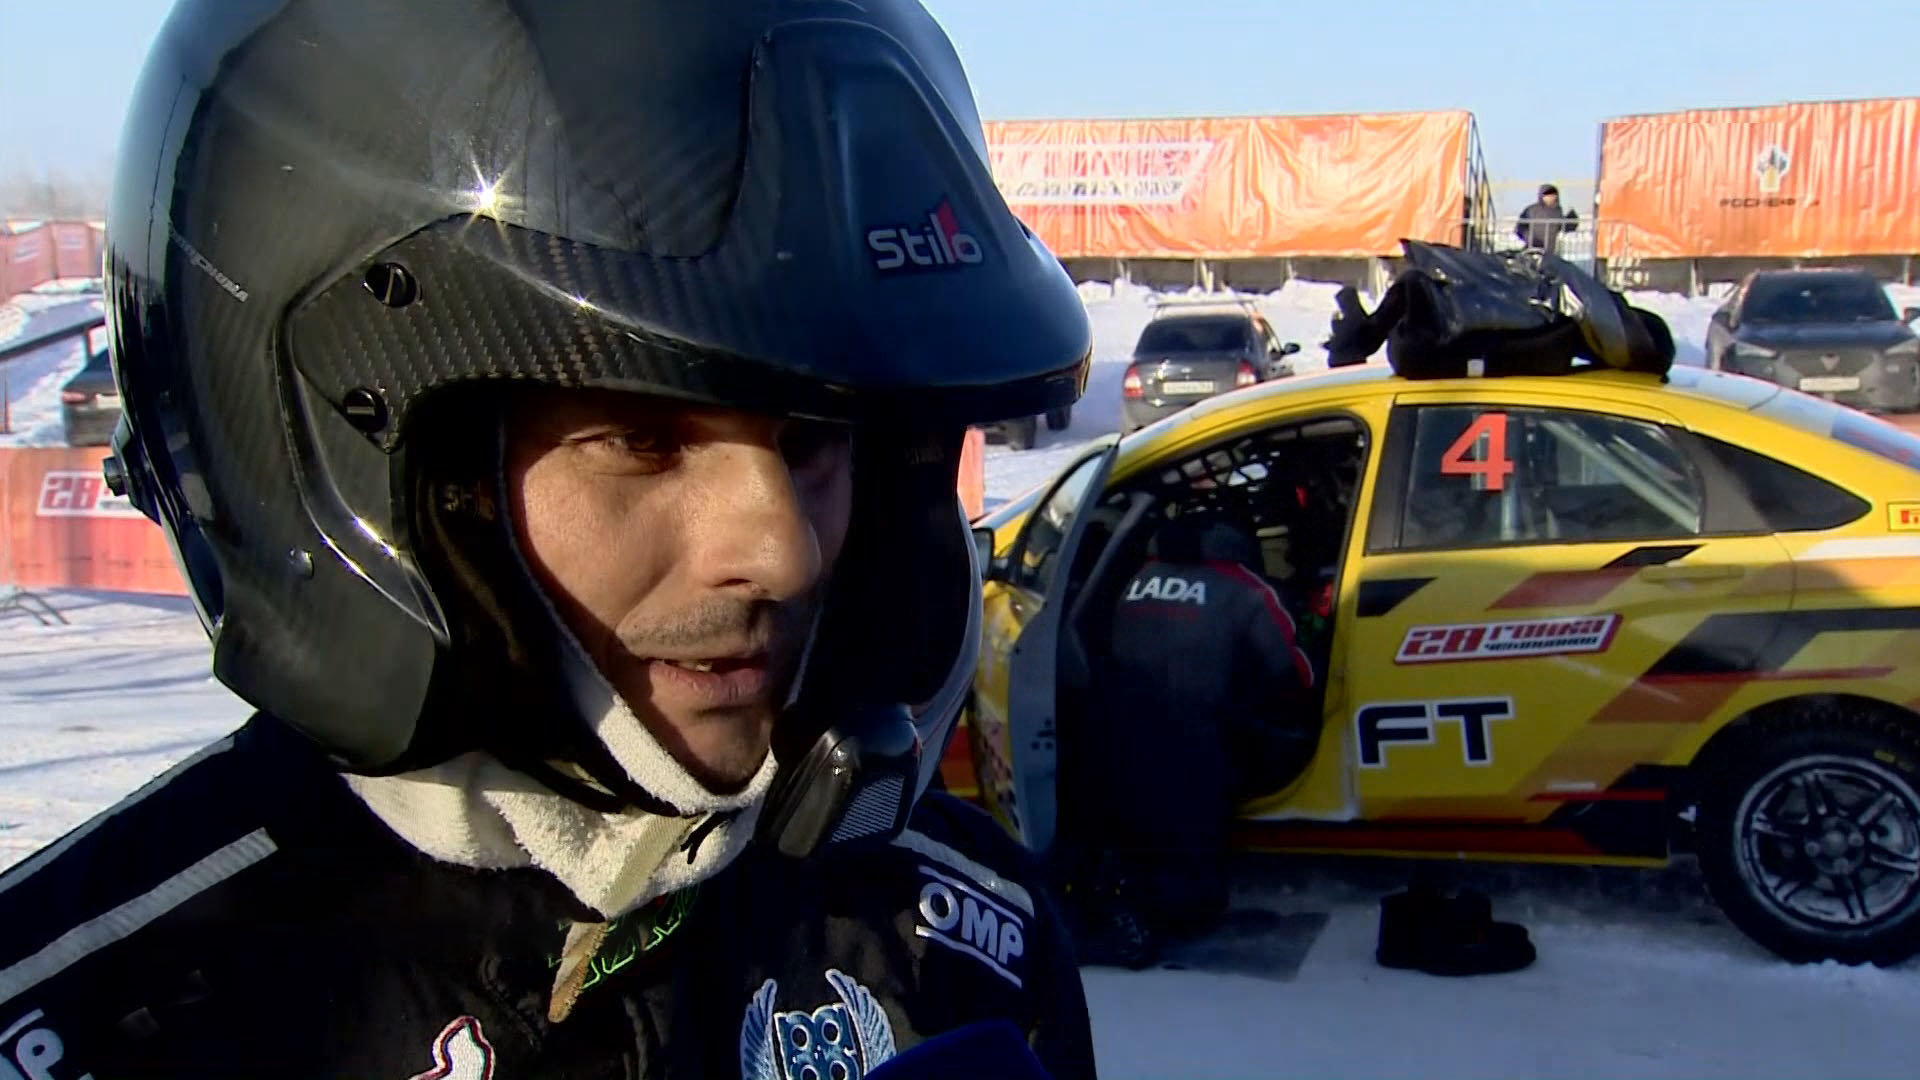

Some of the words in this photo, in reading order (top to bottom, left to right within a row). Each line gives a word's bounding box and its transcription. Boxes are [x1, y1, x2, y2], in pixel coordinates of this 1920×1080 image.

[868, 204, 984, 269] Stilo
[1440, 411, 1514, 491] 4
[1126, 576, 1206, 605] LADA
[1356, 698, 1511, 766] FT
[918, 881, 1024, 965] OMP
